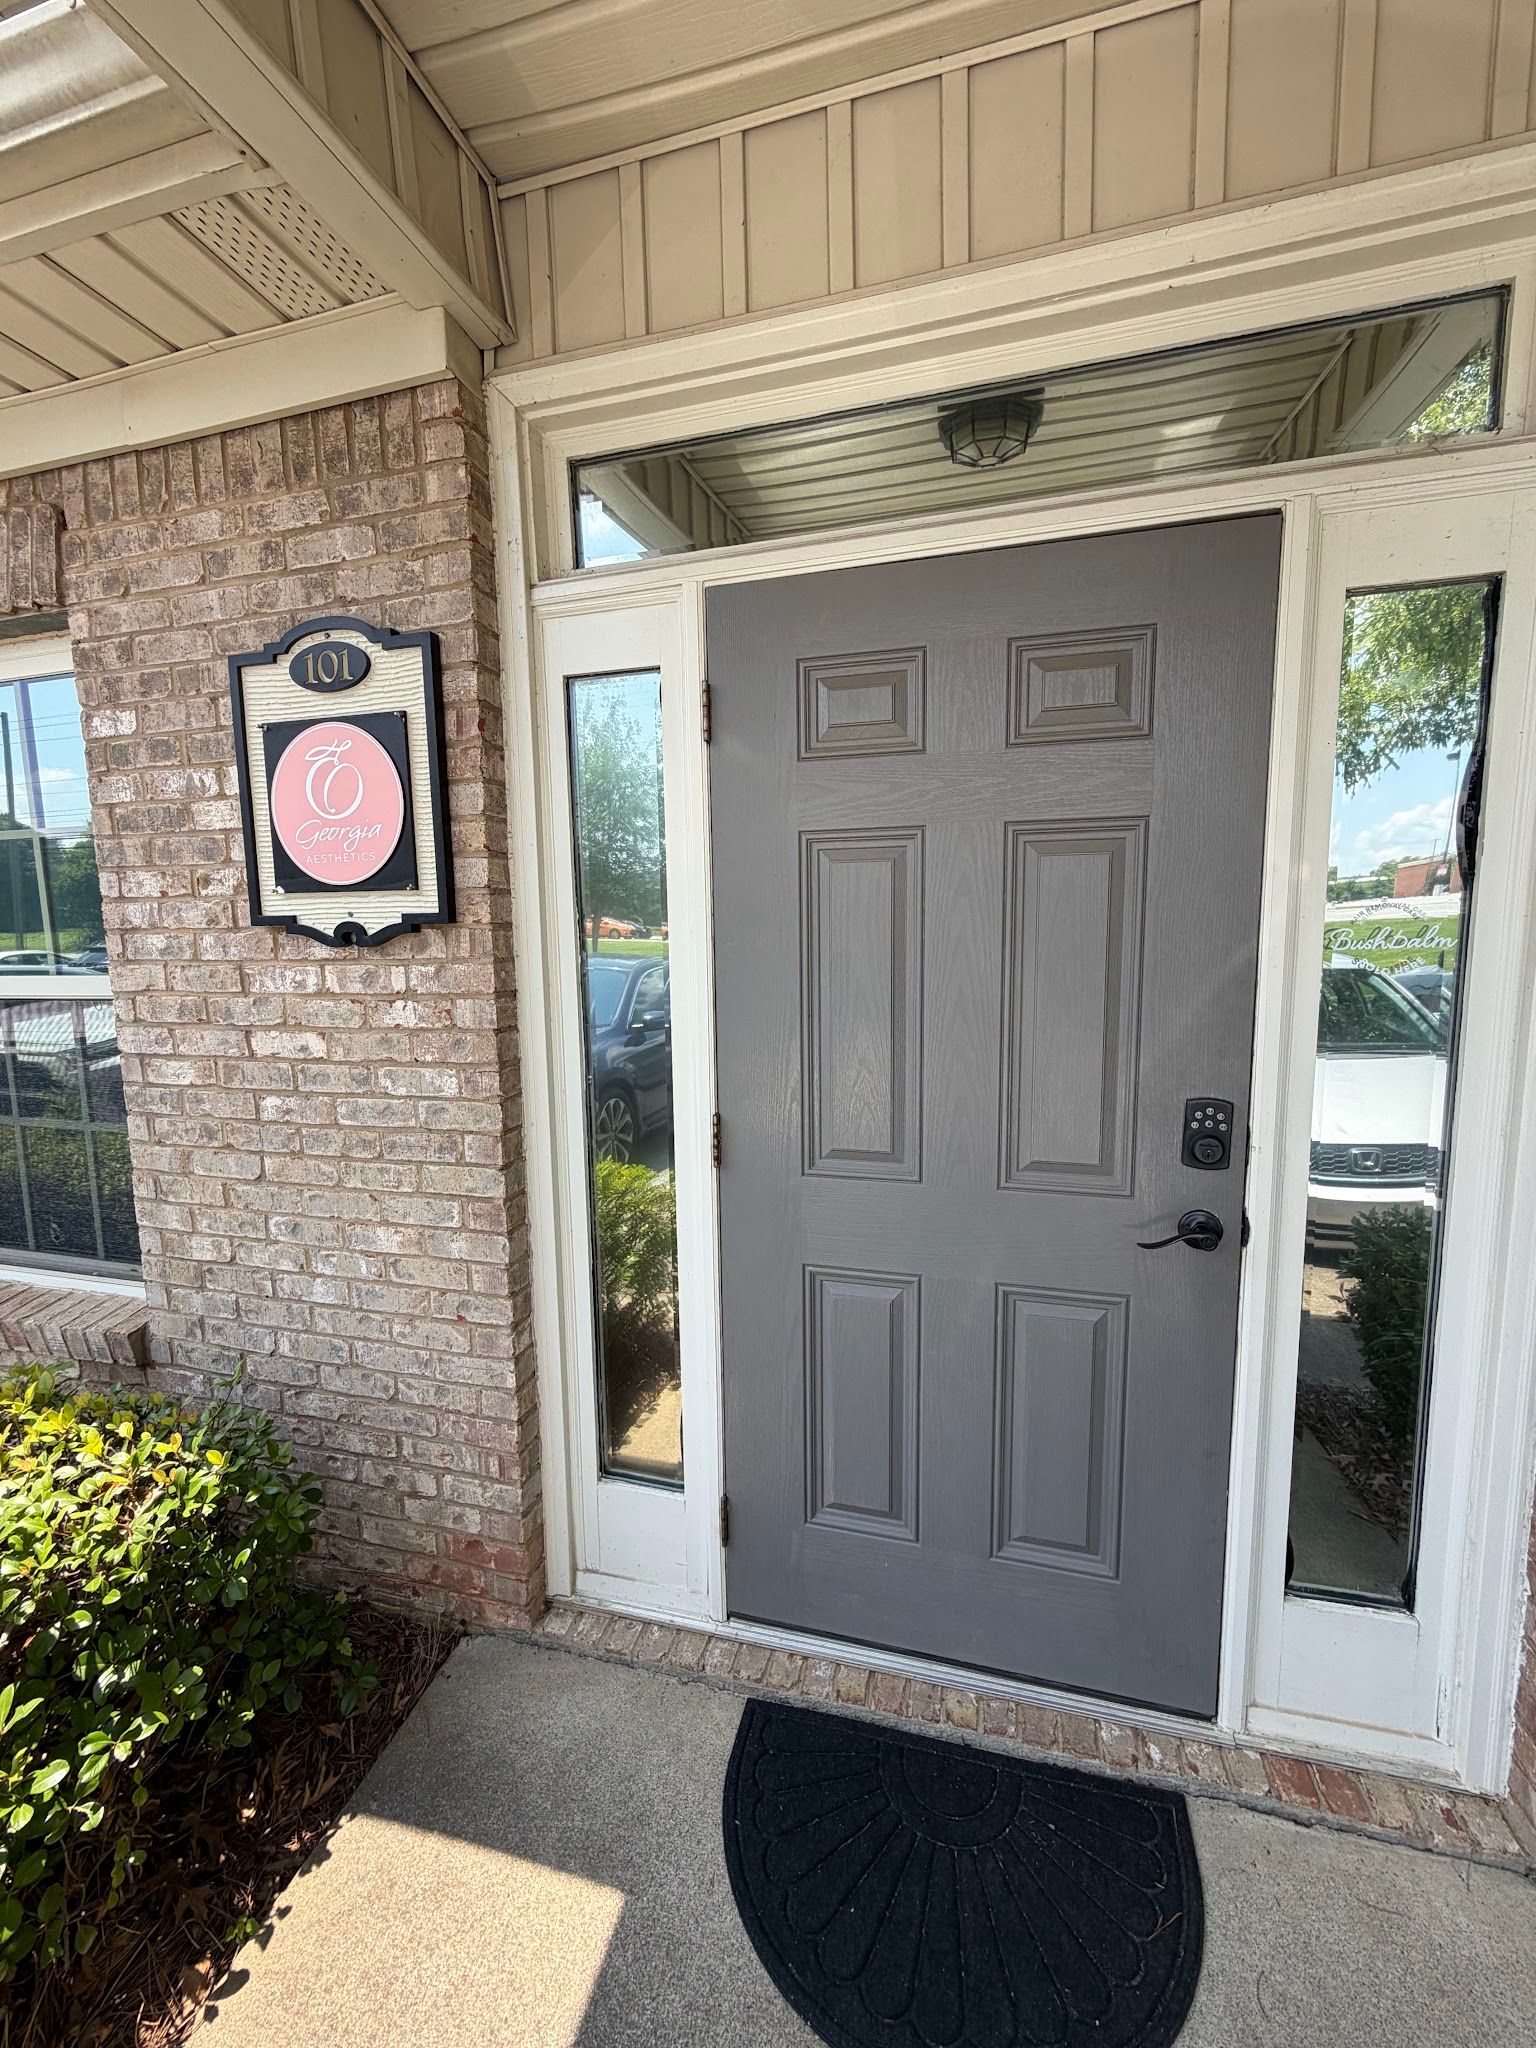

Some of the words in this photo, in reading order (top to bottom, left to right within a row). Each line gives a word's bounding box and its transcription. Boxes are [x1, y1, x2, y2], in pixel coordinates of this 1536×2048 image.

[303, 648, 354, 685] 101
[295, 819, 382, 852] Georgia
[306, 851, 376, 864] AESTHETICS
